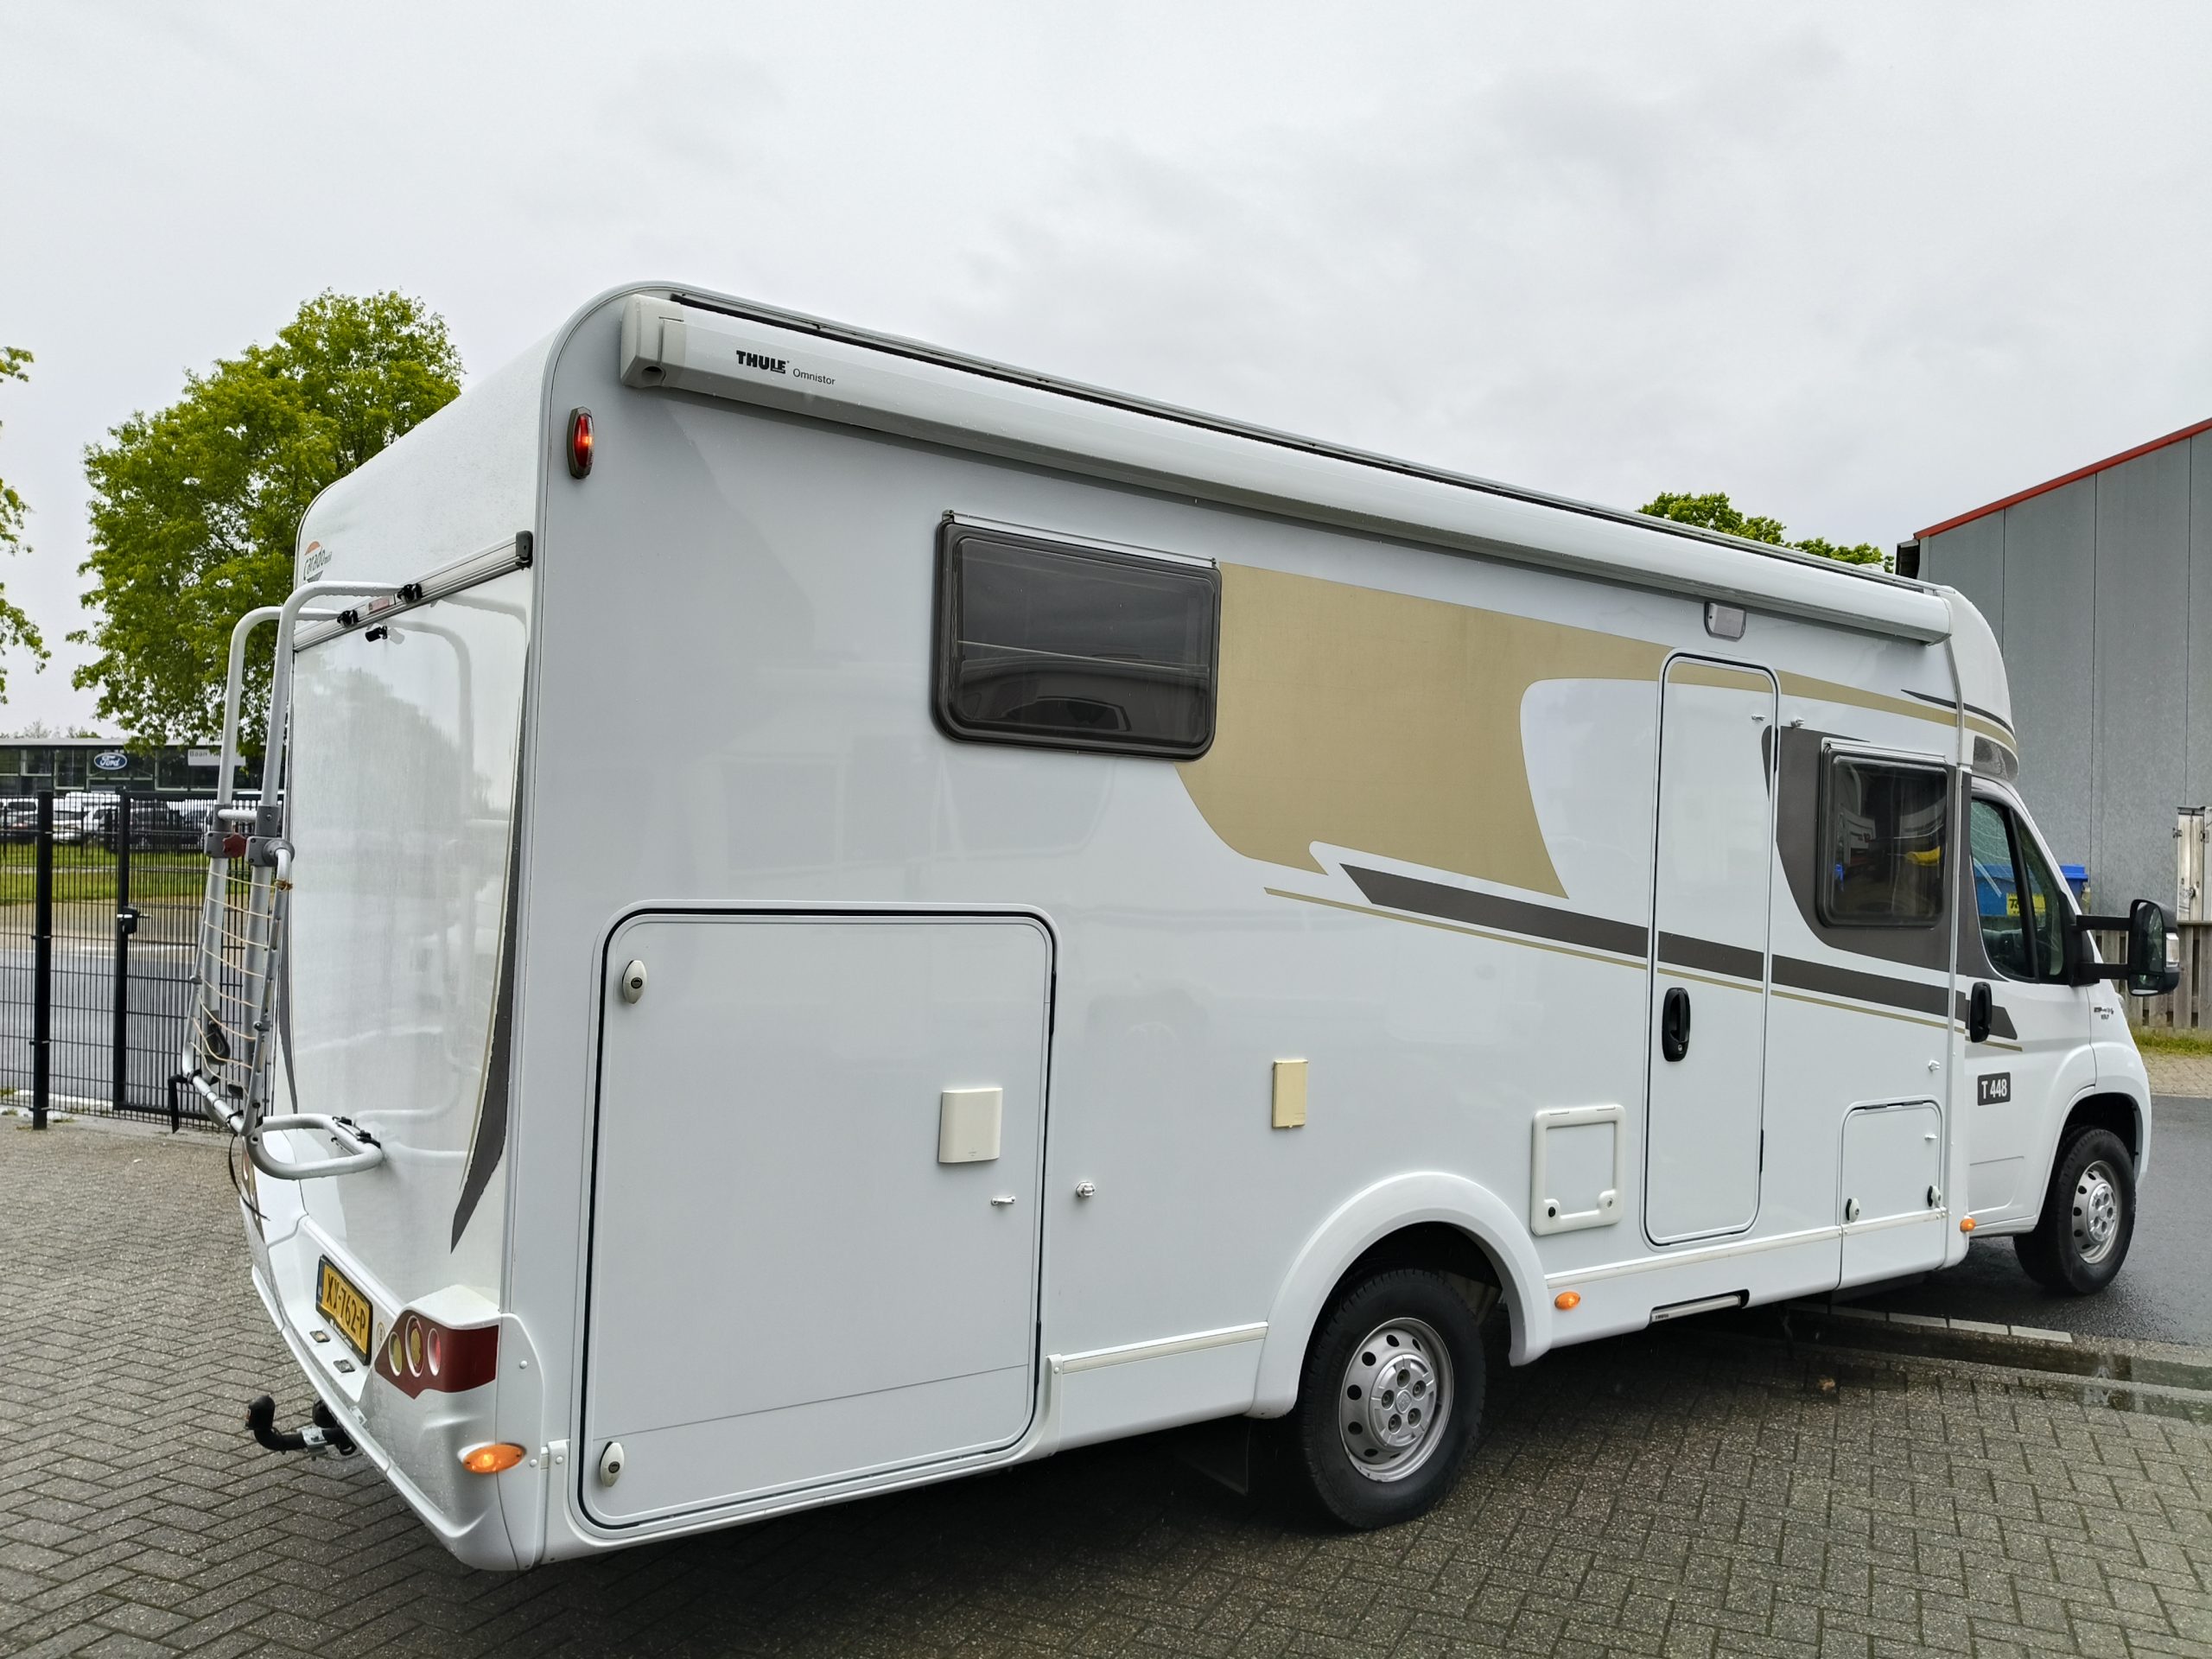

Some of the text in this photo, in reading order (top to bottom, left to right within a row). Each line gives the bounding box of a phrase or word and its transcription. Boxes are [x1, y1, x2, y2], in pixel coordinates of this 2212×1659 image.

[736, 350, 836, 385] THULE Omnistor
[1981, 1078, 2007, 1099] T 448
